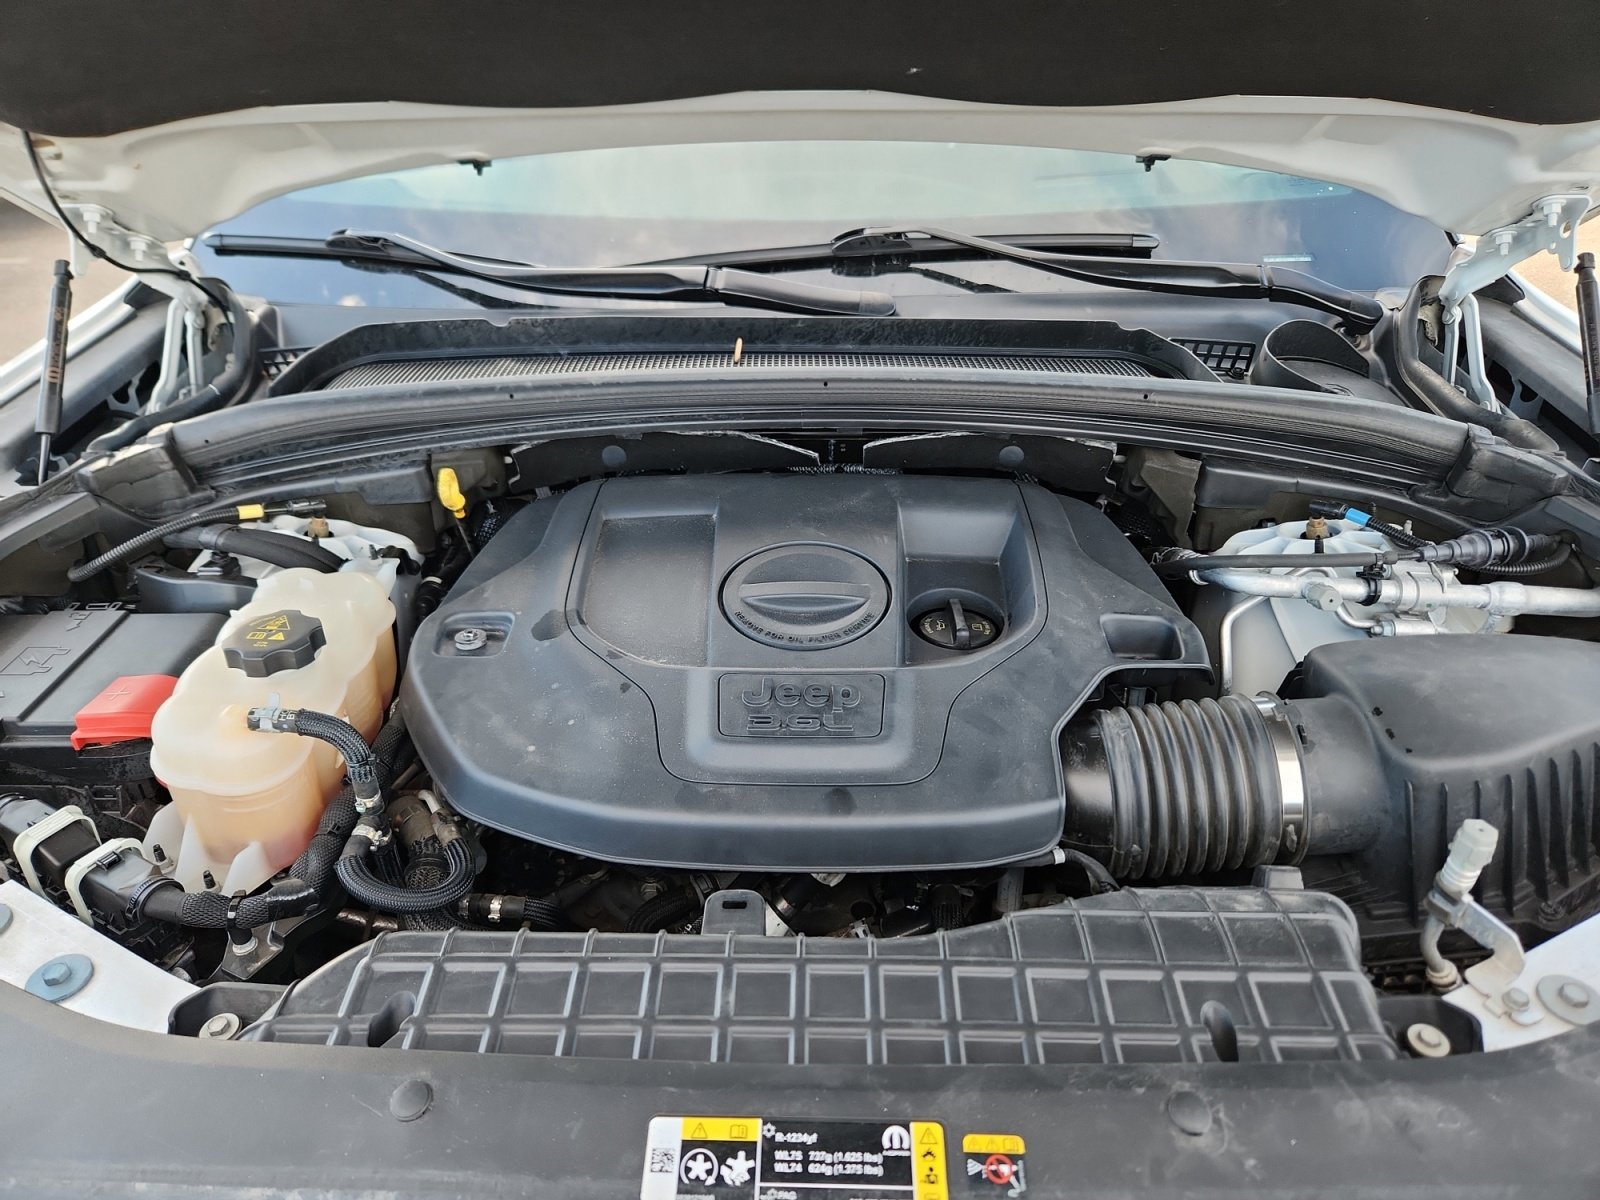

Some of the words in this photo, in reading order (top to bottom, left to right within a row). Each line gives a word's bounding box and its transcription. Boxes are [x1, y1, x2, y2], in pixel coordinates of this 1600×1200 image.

[765, 631, 784, 640] FOR
[788, 636, 804, 644] OIL
[741, 677, 861, 713] Jeep
[747, 713, 854, 731] 3.6L
